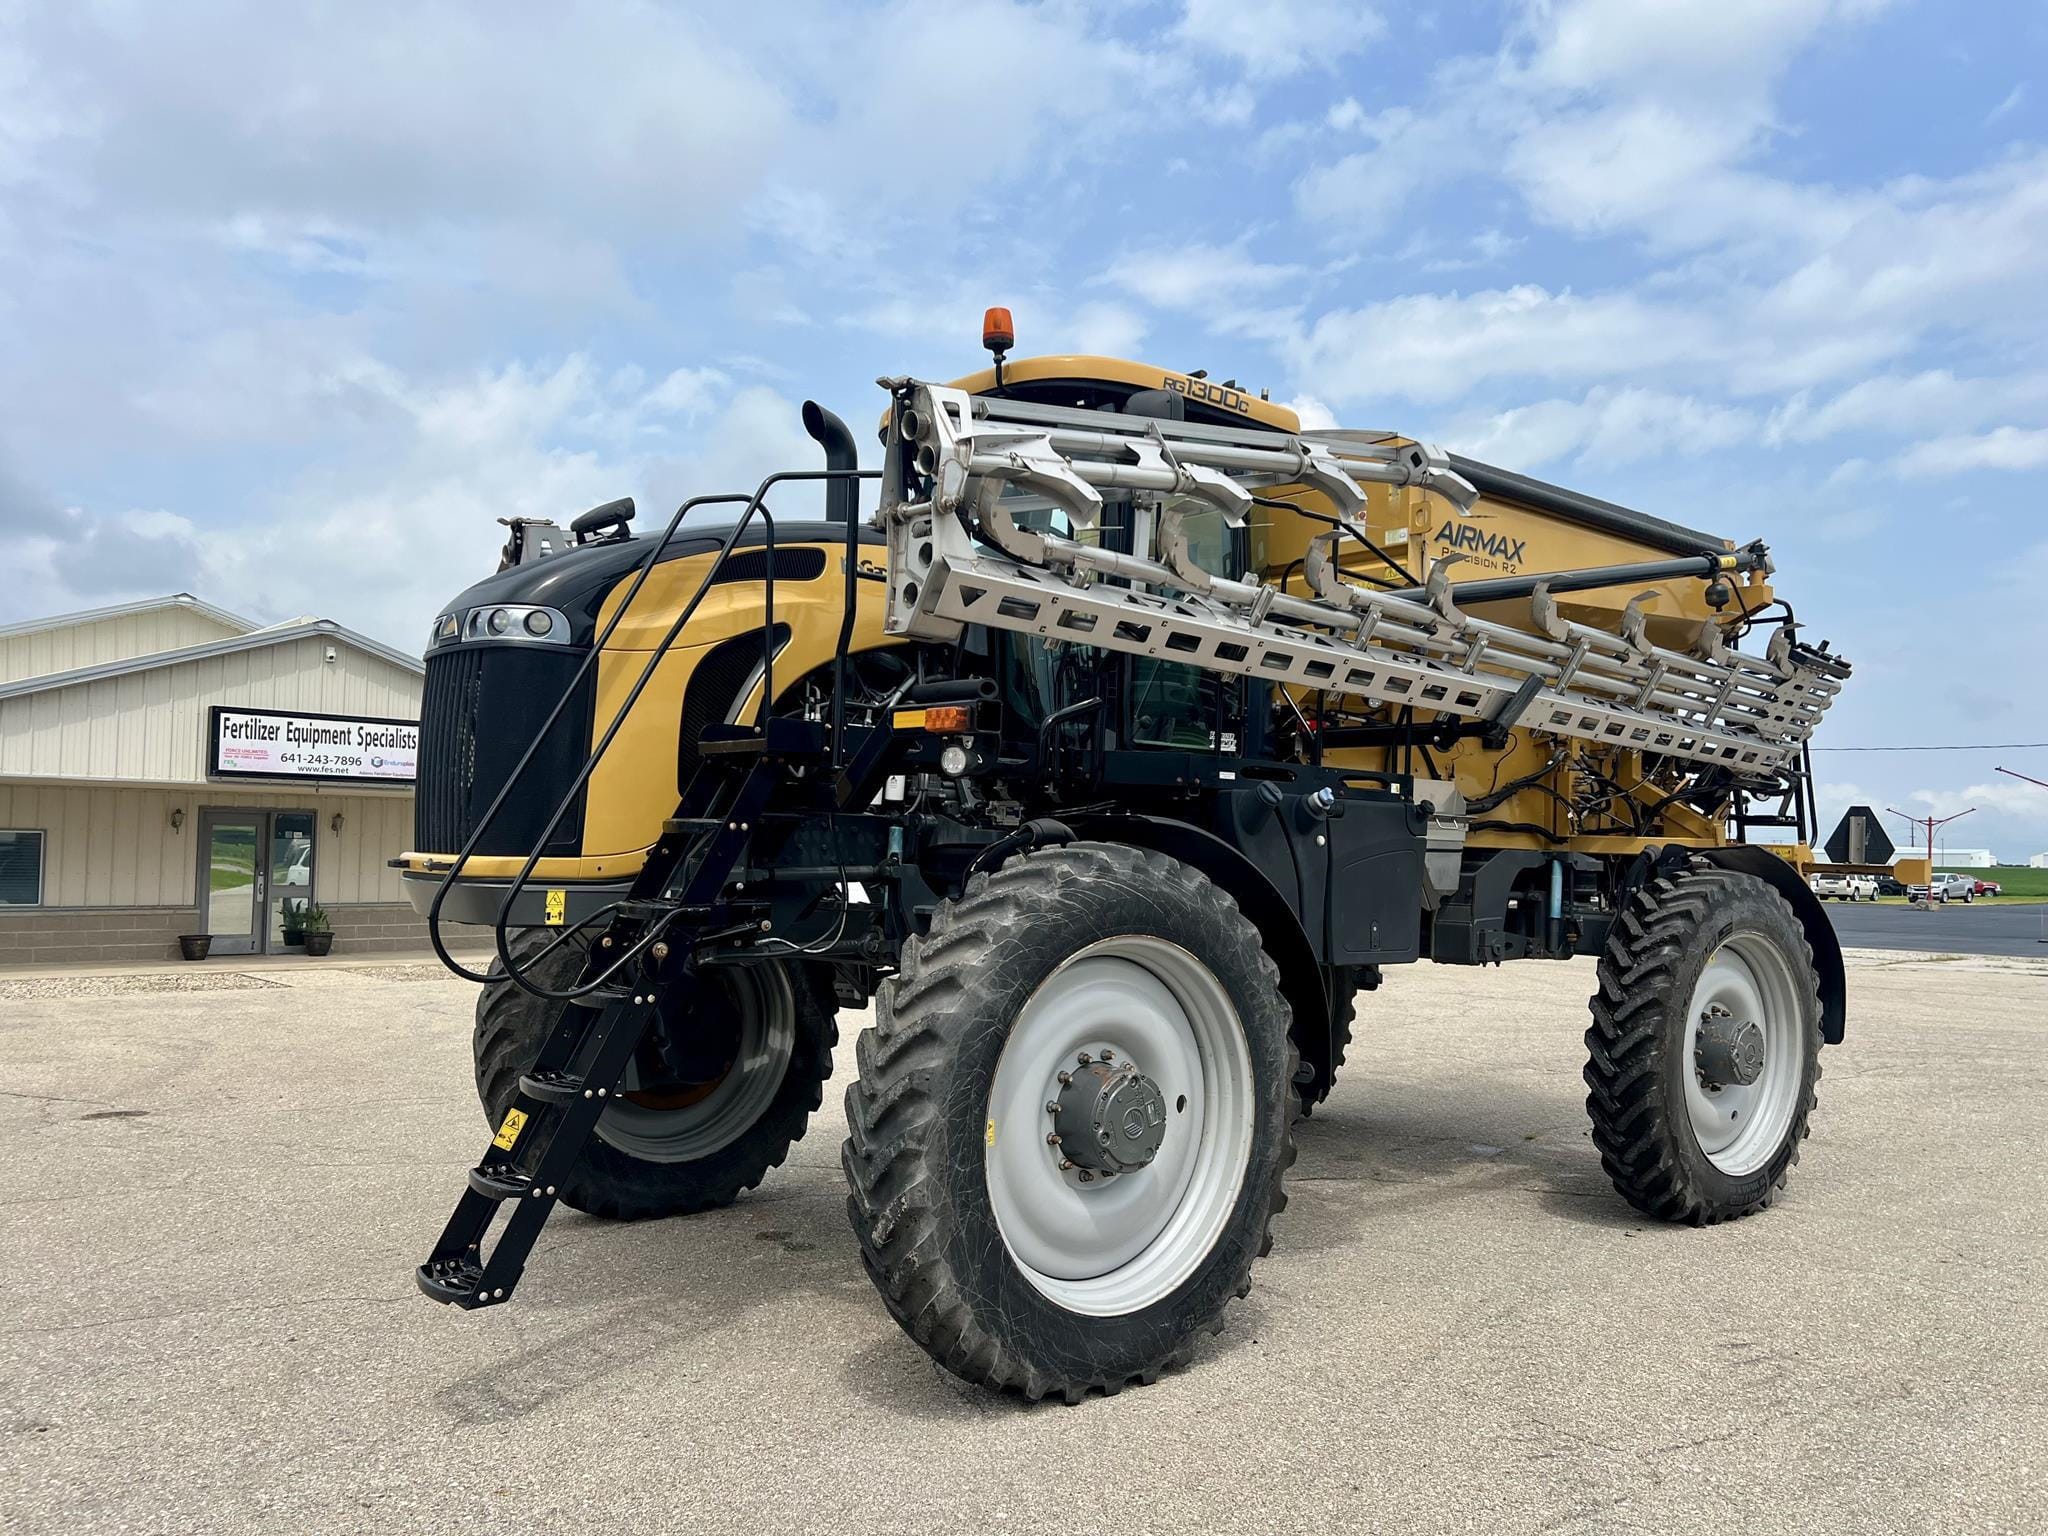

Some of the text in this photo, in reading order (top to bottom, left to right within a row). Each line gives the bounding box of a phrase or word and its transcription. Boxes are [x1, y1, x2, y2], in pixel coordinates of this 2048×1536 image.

[1434, 520, 1526, 564] AIRMAX
[1441, 546, 1517, 575] PISION R2
[223, 717, 417, 753] Fertilizer Equipment Specialists
[280, 752, 362, 766] 641-243-7896
[297, 765, 349, 774] www.fes.net
